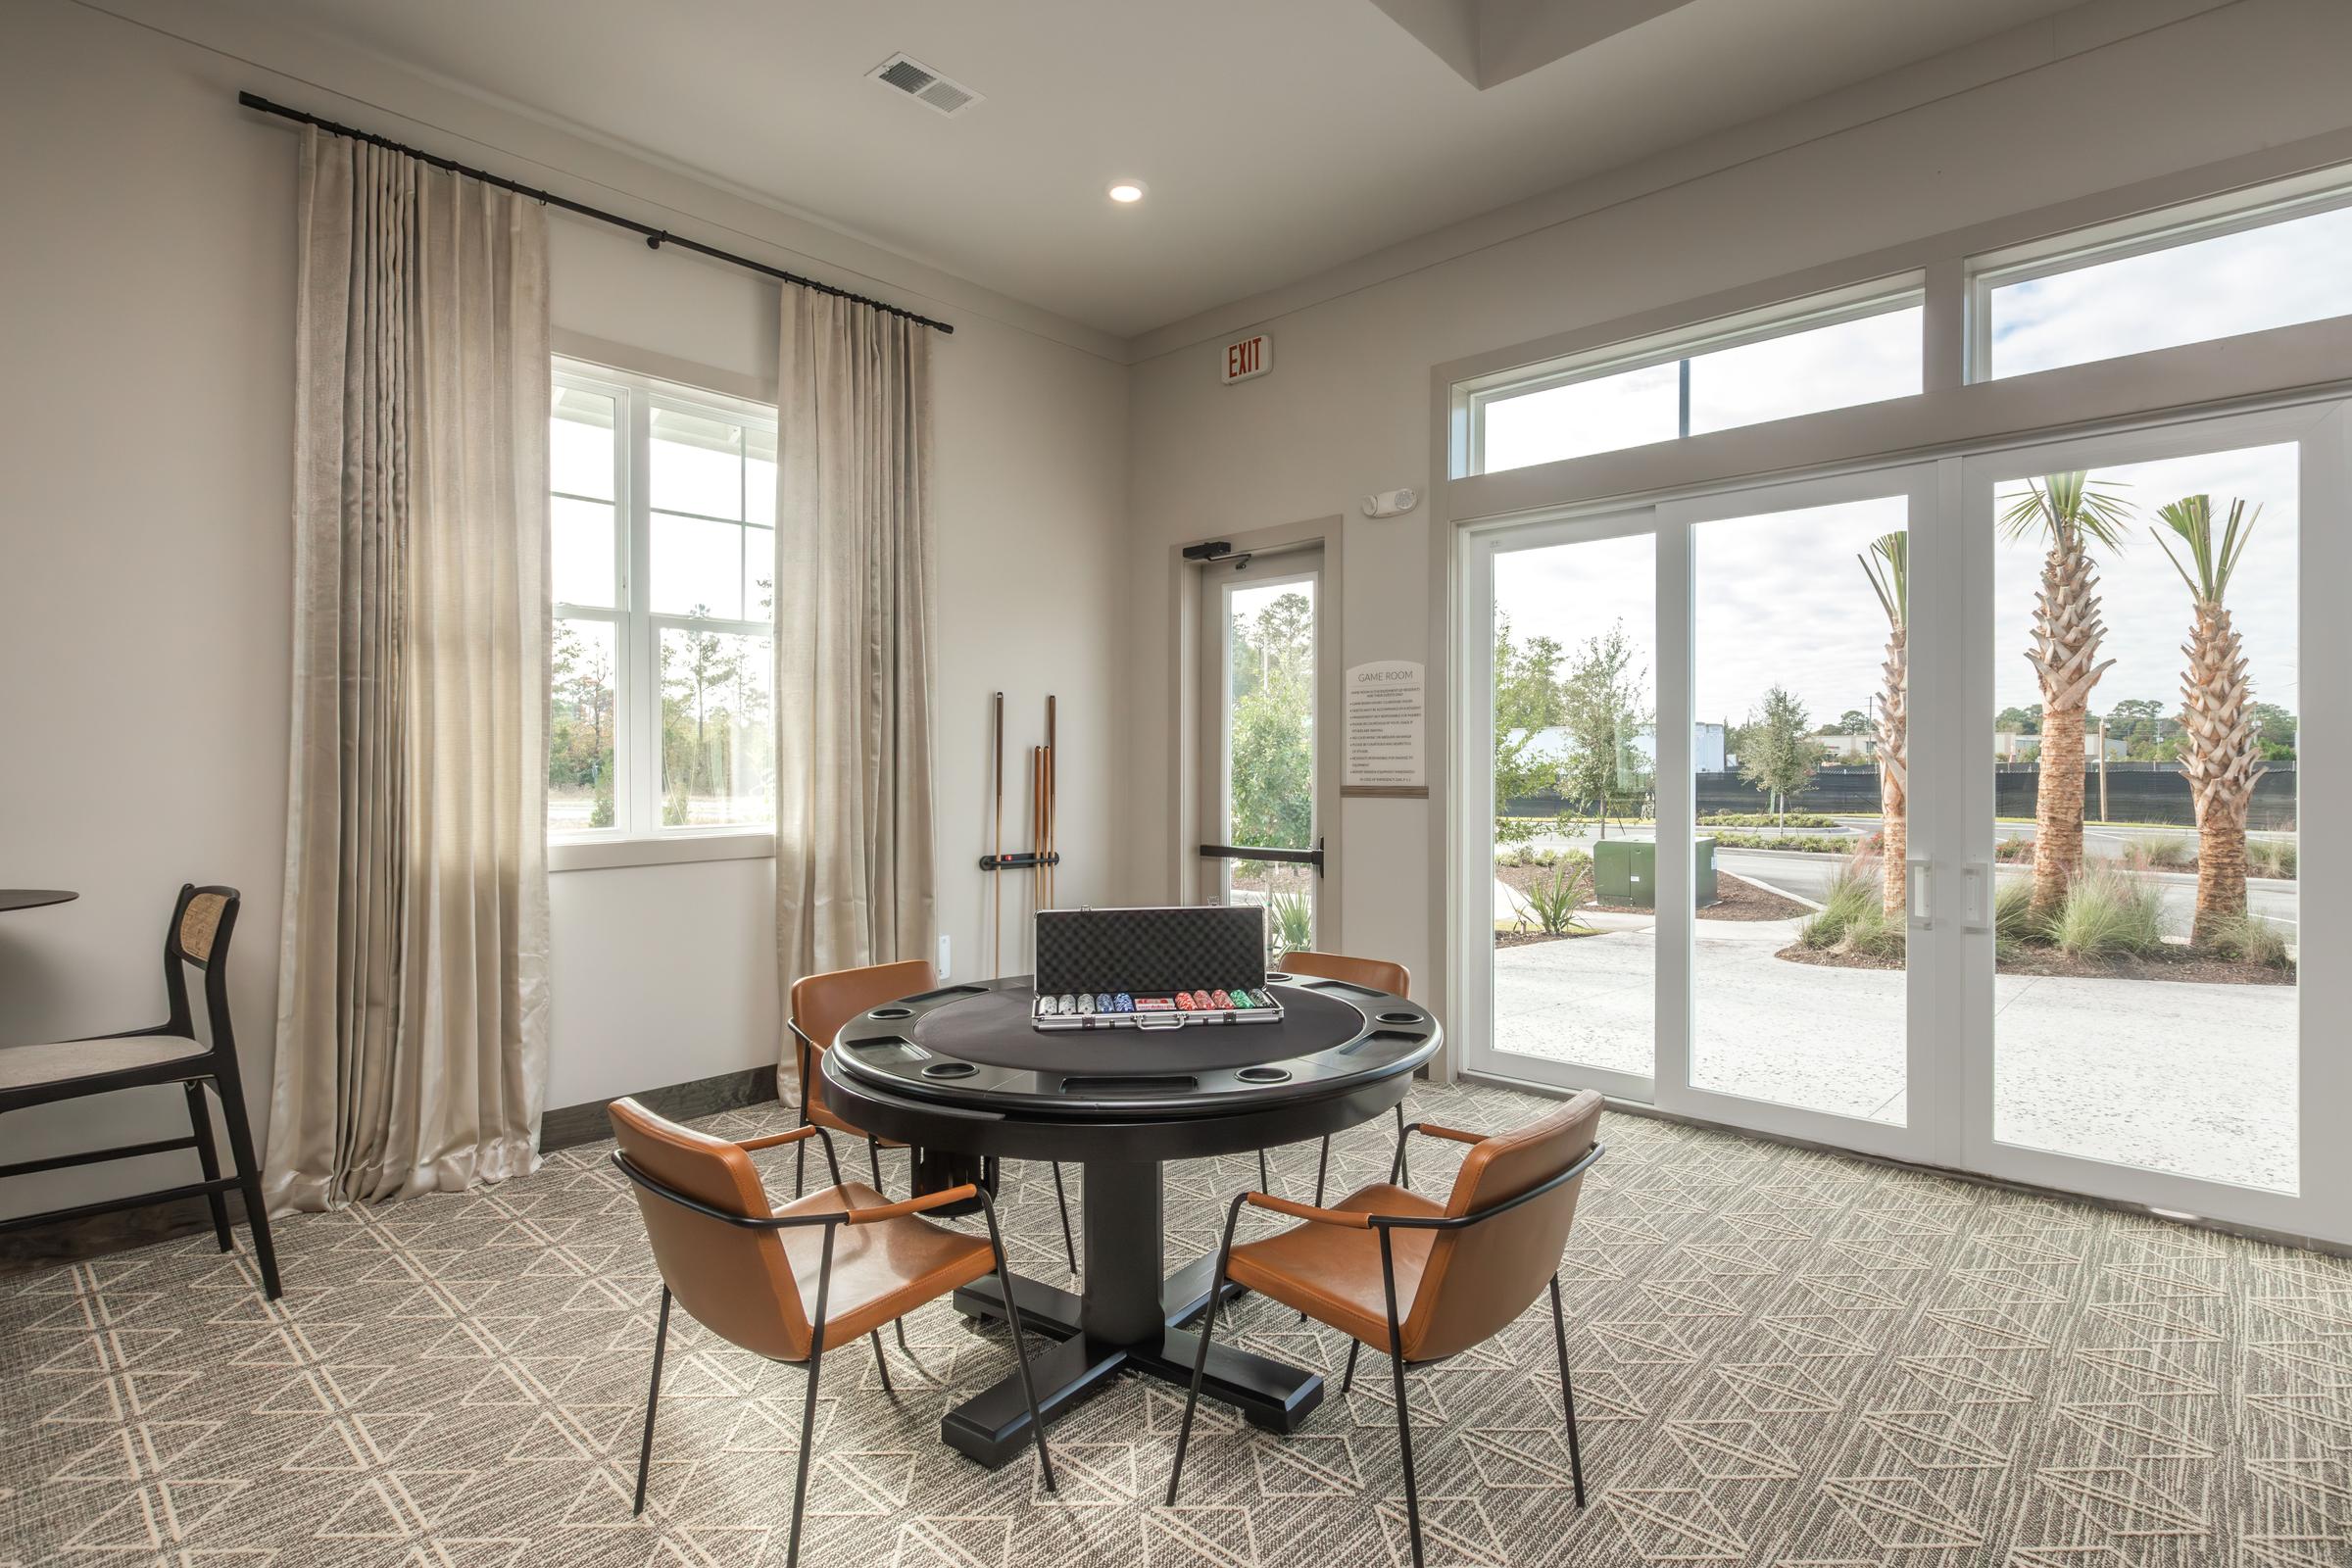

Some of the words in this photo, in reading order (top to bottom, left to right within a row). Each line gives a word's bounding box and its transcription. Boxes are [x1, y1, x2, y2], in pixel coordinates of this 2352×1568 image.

[1229, 337, 1262, 378] EXIT
[1358, 672, 1384, 682] GAME
[1386, 670, 1413, 681] ROOM
